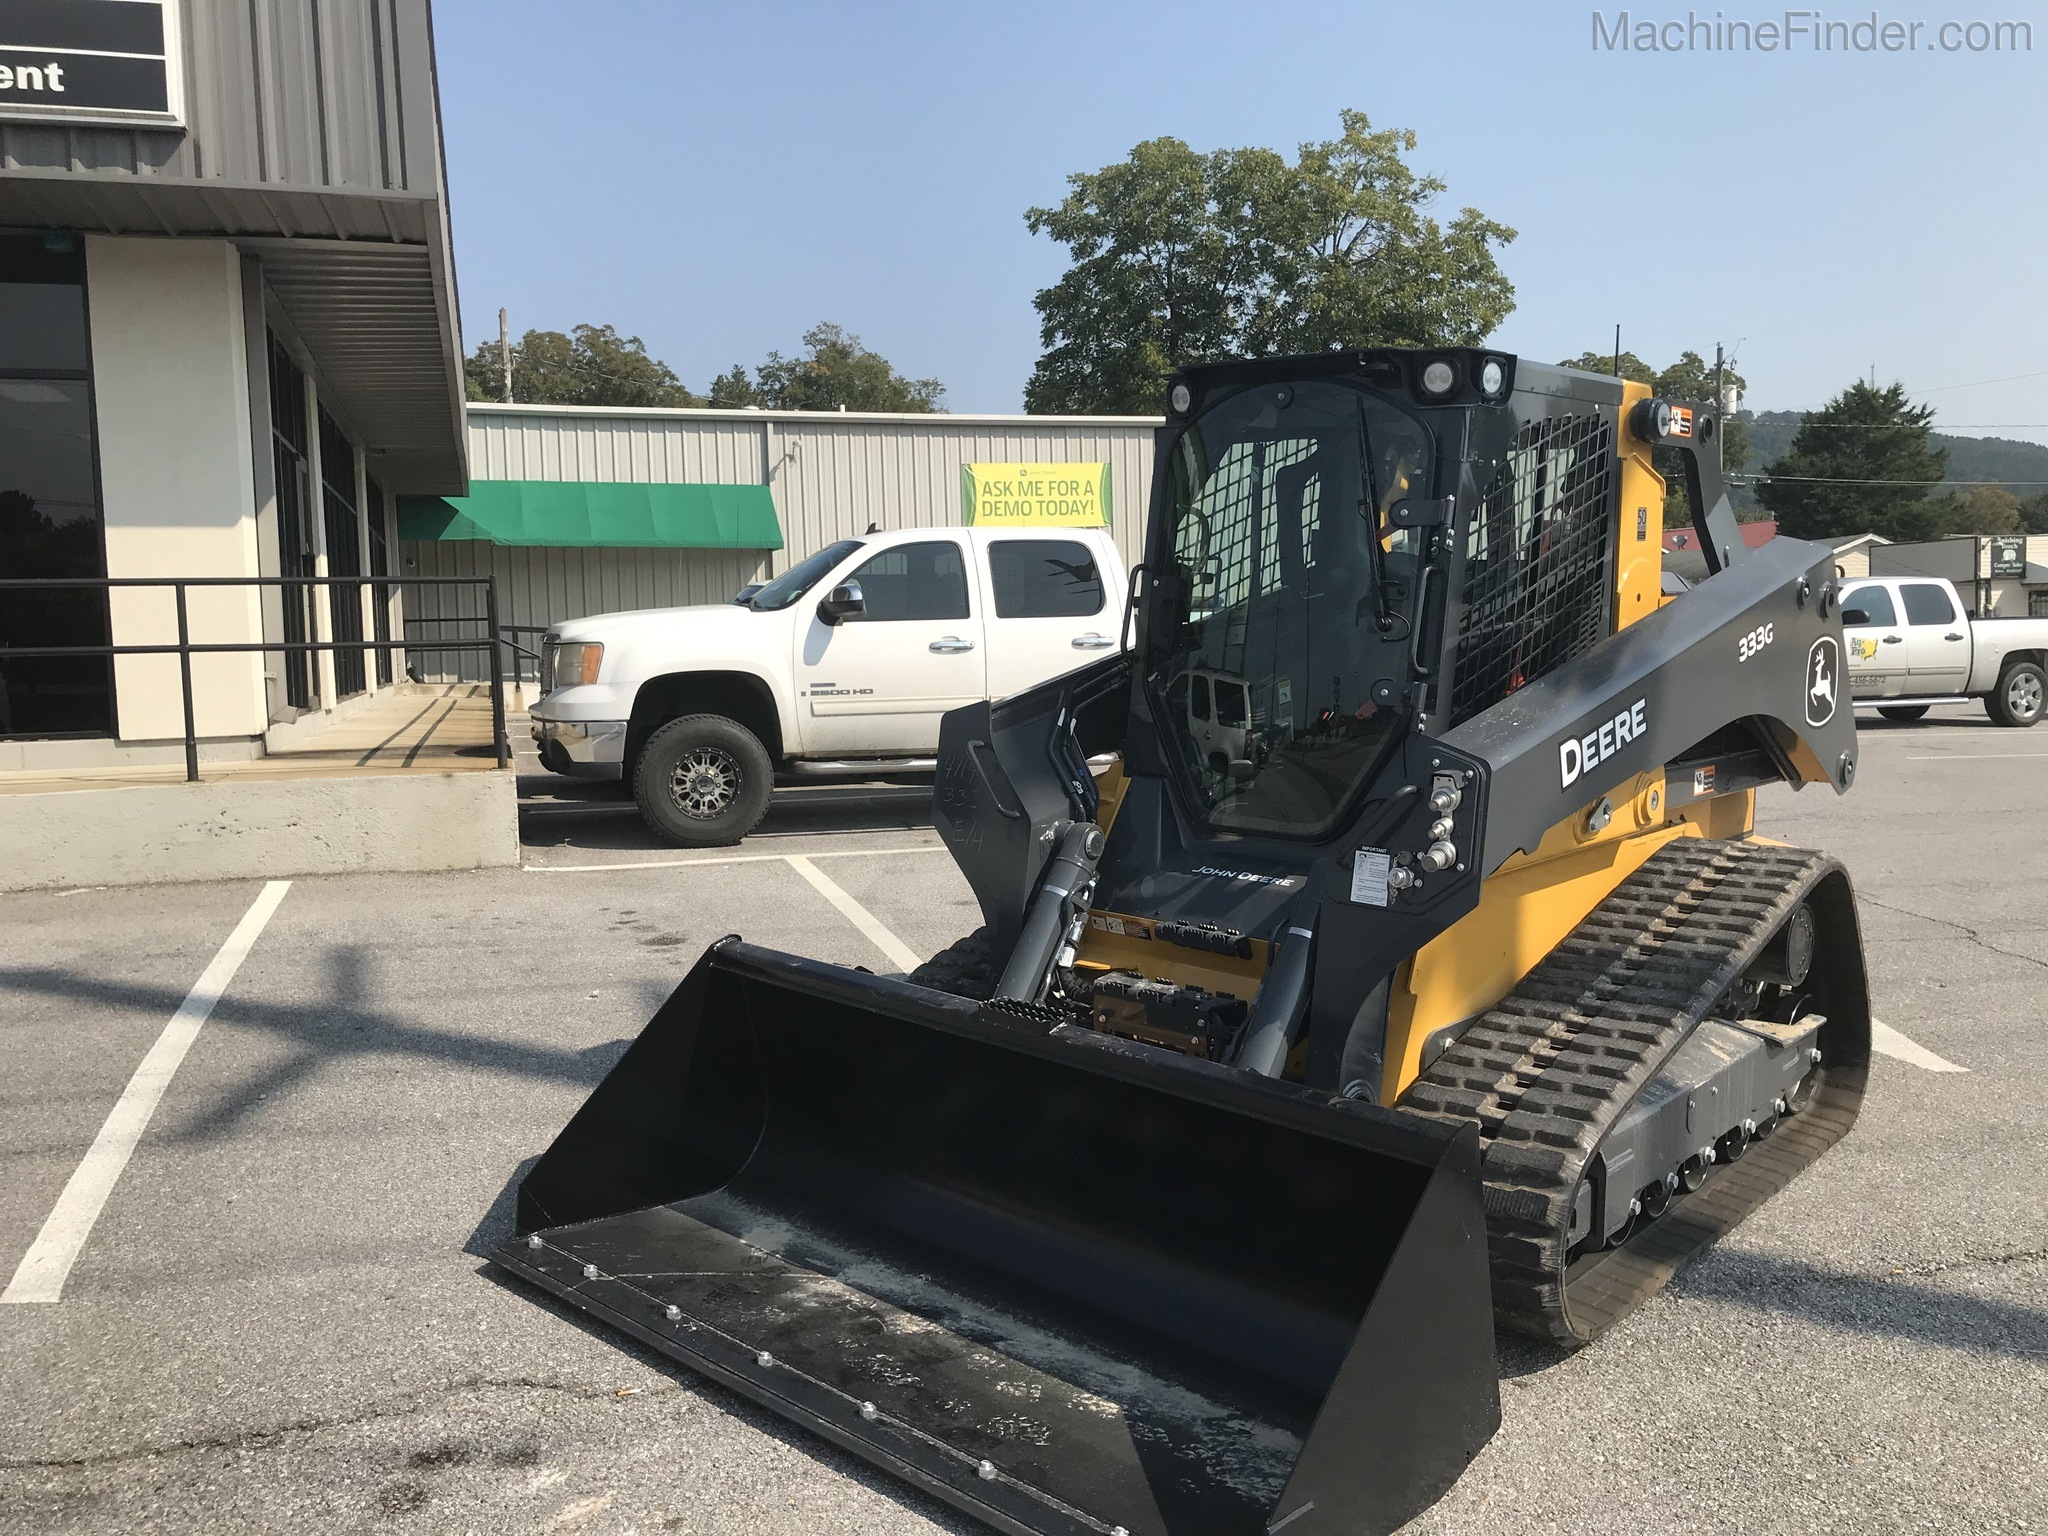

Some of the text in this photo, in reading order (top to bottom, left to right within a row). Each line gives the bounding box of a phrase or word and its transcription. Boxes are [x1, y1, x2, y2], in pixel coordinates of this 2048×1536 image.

[982, 480, 1095, 497] ASK ME FOR A
[982, 499, 1095, 517] DEMO TODAY!
[1738, 622, 1774, 663] 333G
[1851, 647, 1866, 656] Pro
[1559, 697, 1648, 790] DEERE
[1361, 845, 1388, 854] IMPORTANT
[1191, 865, 1295, 887] JOHN DEERE
